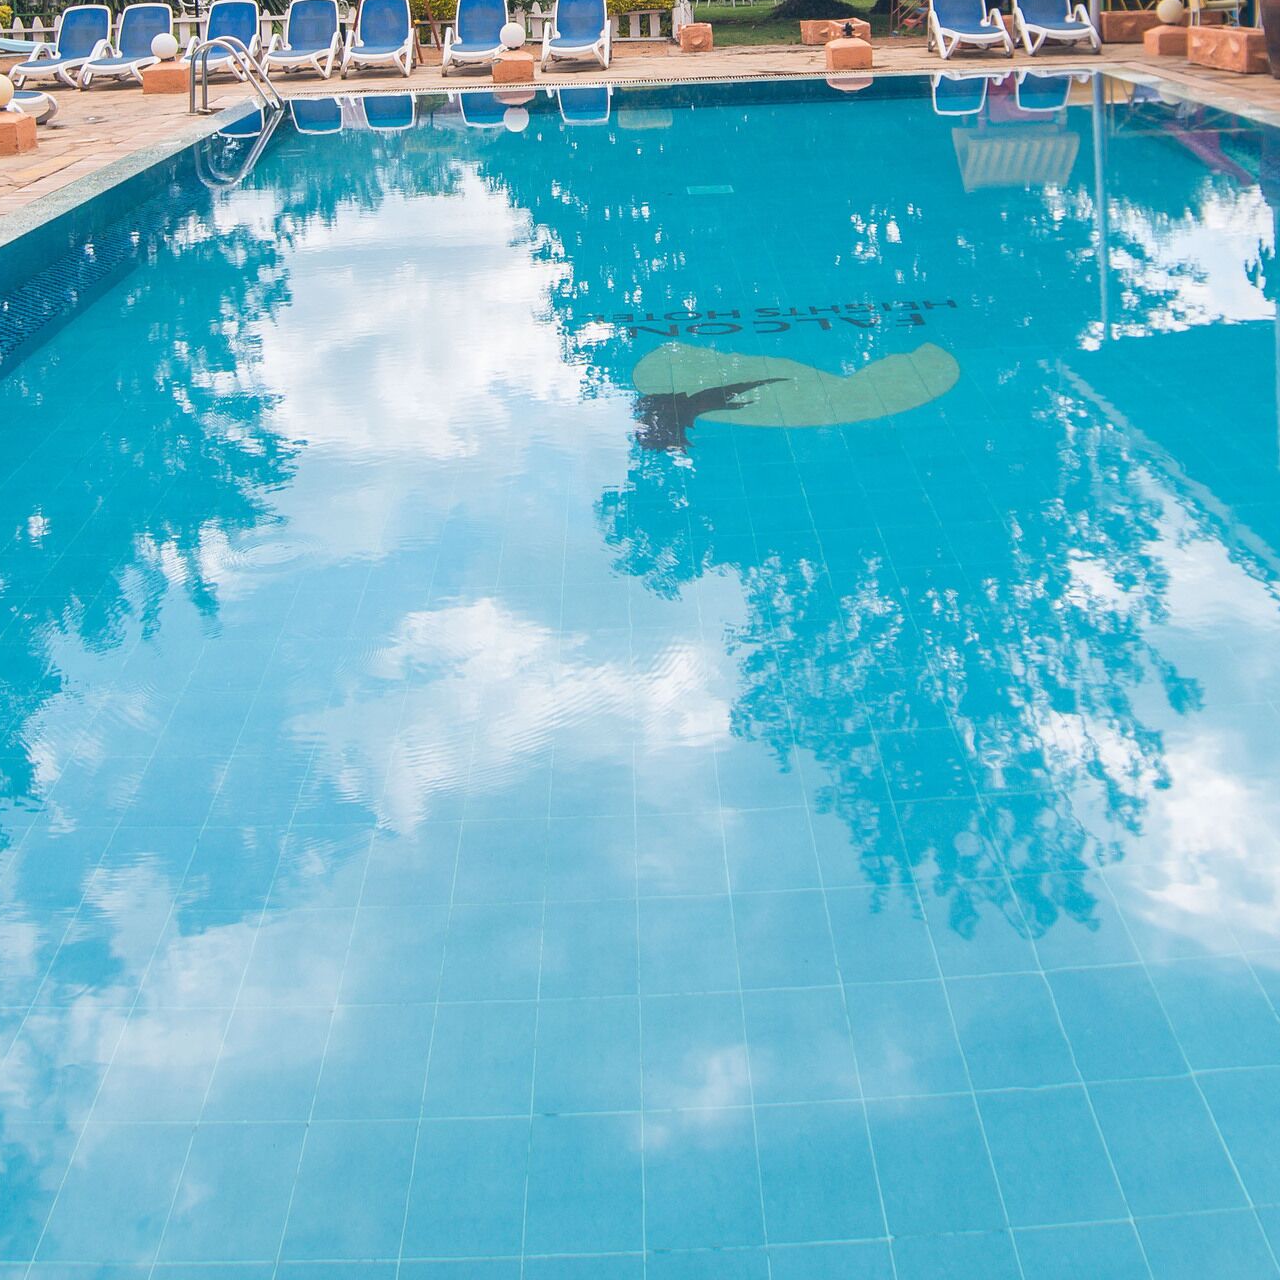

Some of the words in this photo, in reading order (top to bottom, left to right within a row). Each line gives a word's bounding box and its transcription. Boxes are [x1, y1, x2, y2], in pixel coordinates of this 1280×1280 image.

[579, 310, 741, 323] HOTEL
[754, 300, 957, 318] HEIGHTS
[628, 313, 926, 338] FALCON
